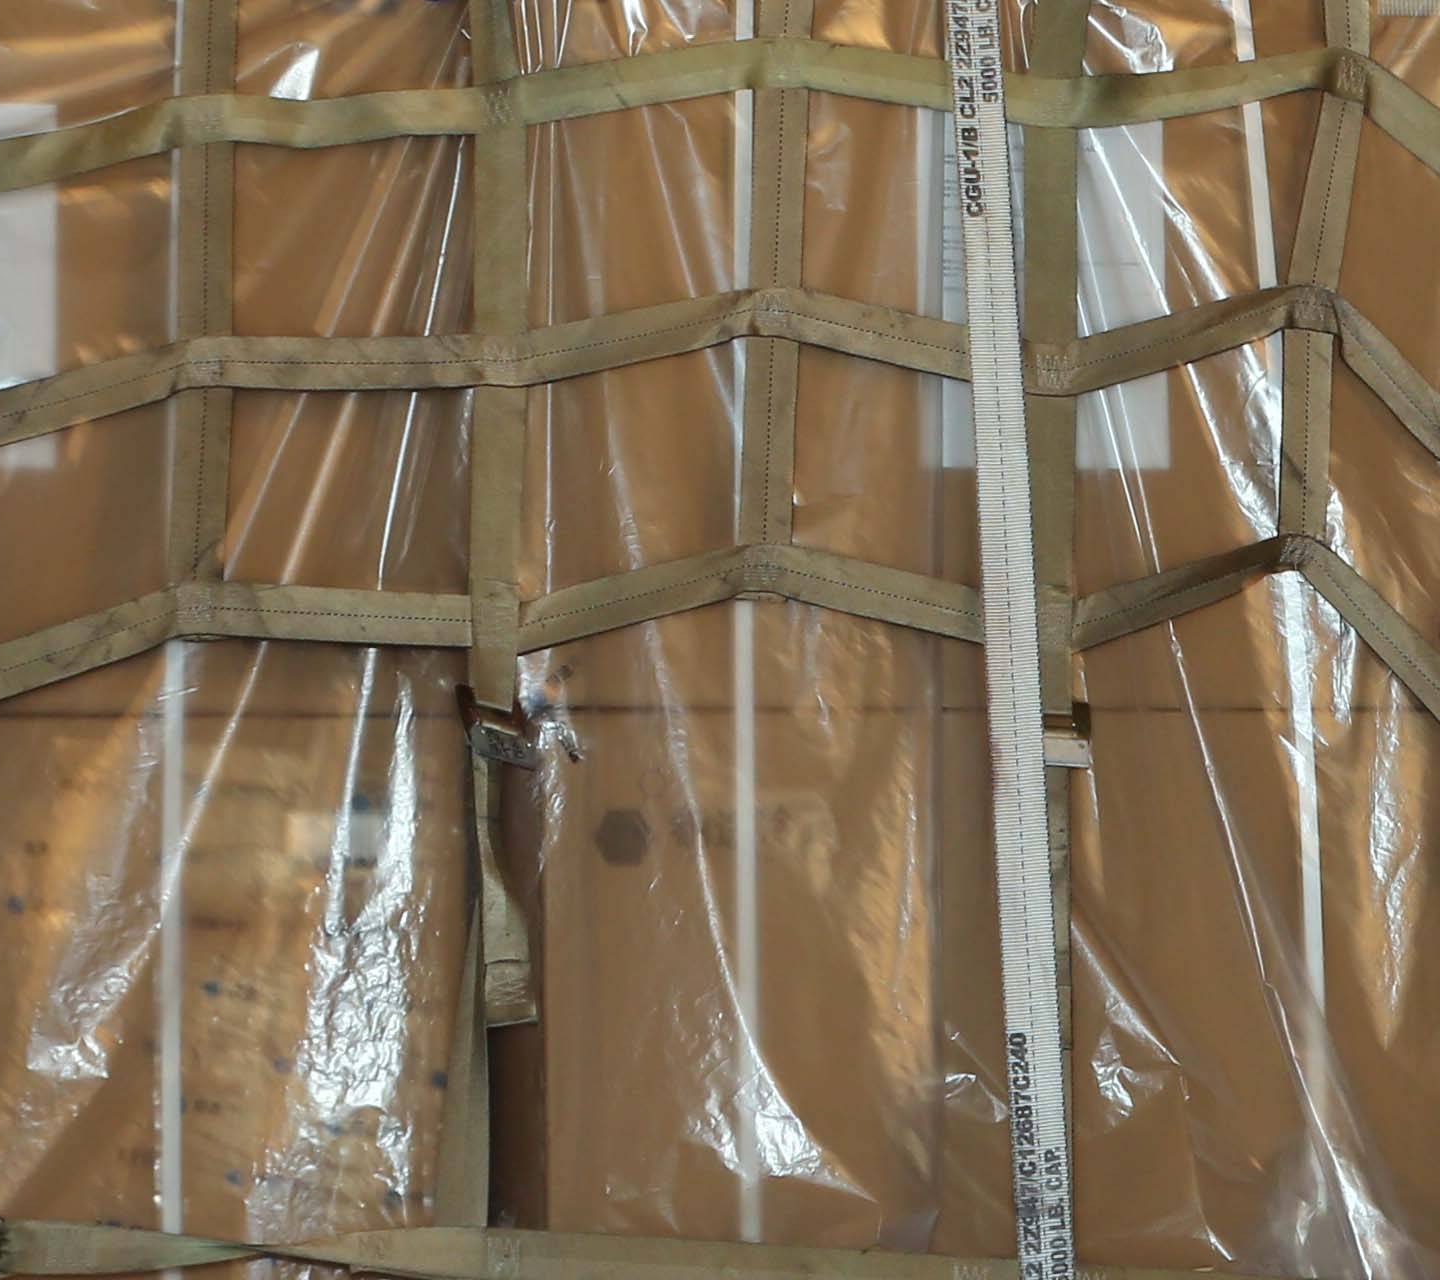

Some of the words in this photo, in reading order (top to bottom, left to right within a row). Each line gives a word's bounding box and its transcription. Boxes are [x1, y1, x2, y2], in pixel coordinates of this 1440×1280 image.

[975, 17, 996, 50] LB.
[956, 75, 977, 119] CL2
[978, 57, 1000, 104] 5000
[961, 127, 985, 218] CGU-1/B
[1047, 1197, 1066, 1230] LB.
